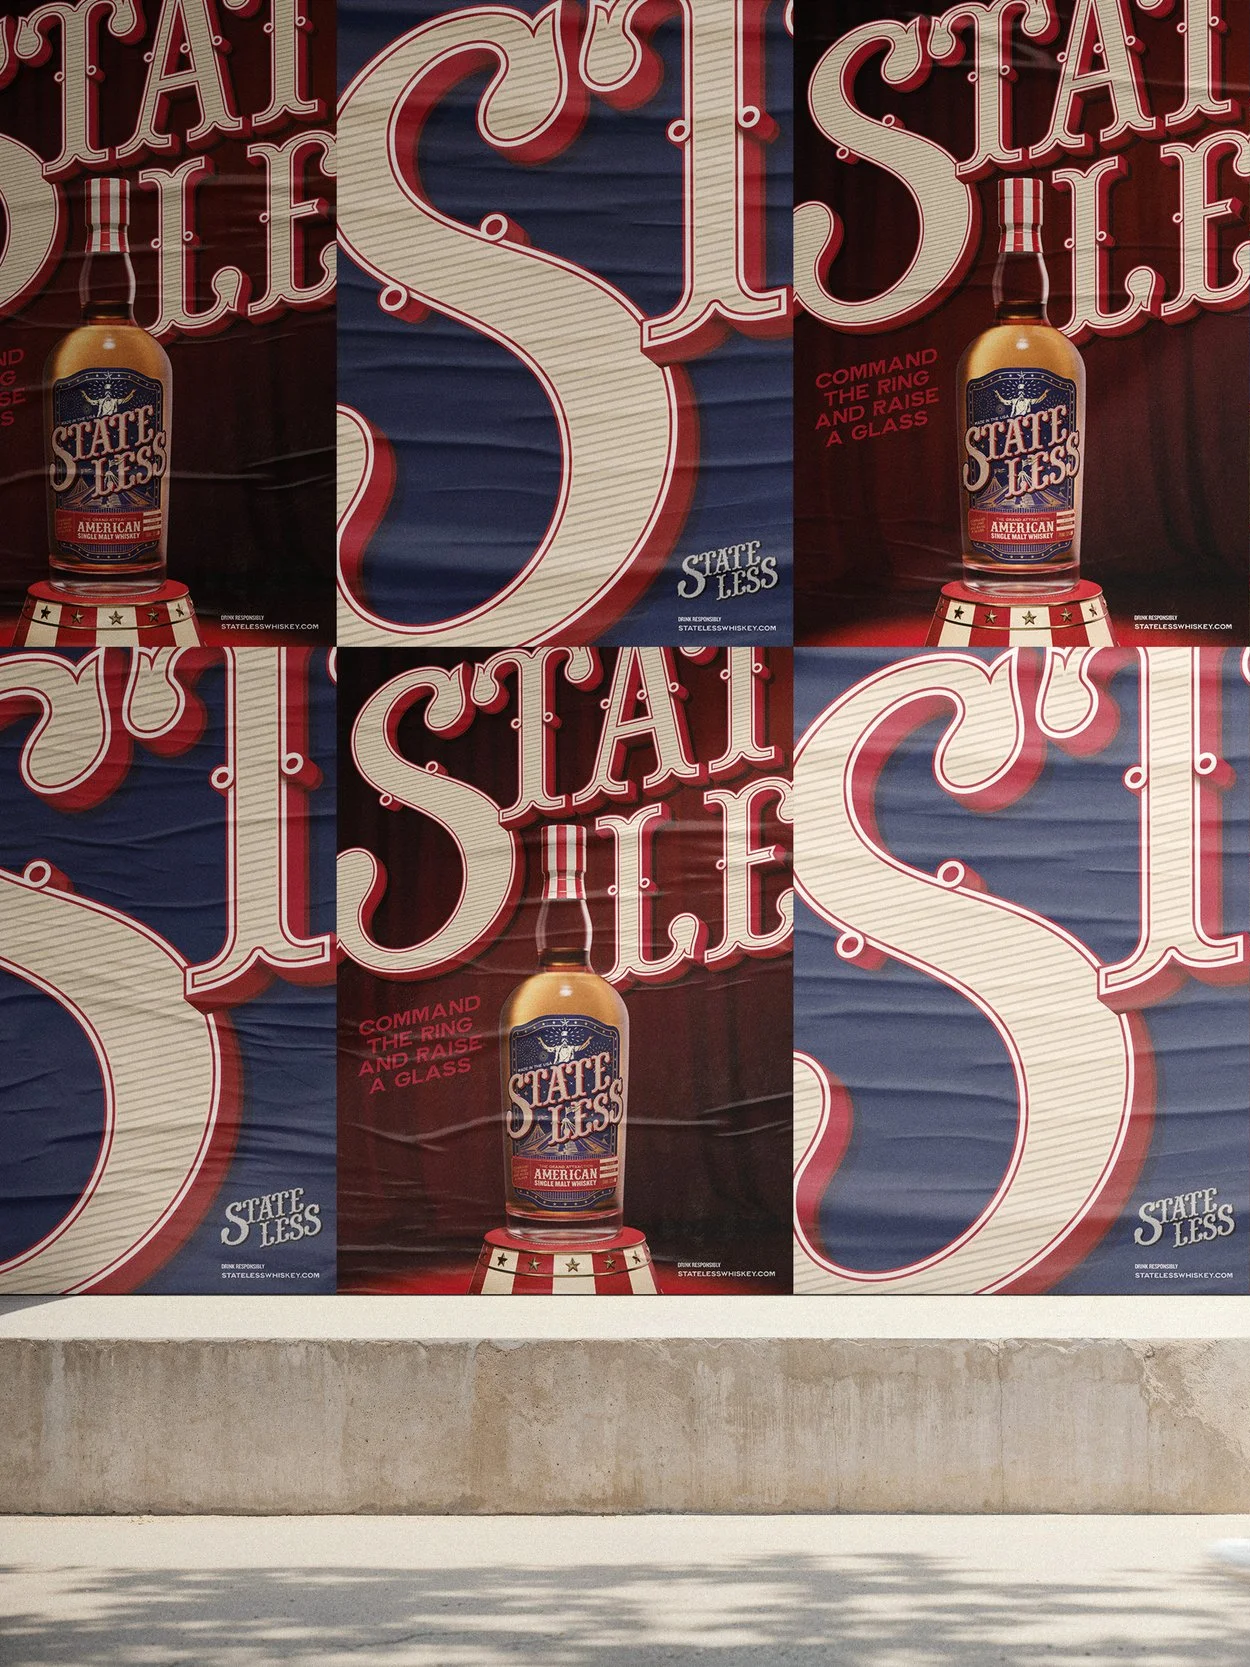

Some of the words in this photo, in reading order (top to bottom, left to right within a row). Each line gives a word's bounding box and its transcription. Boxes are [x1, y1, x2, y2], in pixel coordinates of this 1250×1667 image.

[815, 348, 938, 389] COMMAND
[824, 383, 870, 407] THE
[877, 370, 930, 396] RING
[815, 405, 865, 431] AND
[873, 387, 940, 416] RAISE
[825, 430, 843, 448] A
[851, 410, 928, 440] GLASS
[49, 404, 155, 492] STATE
[91, 430, 167, 499] LESS
[962, 404, 1068, 492] STATE
[1004, 430, 1080, 499] LESS
[78, 521, 141, 533] AMERICAN
[991, 521, 1054, 533] AMERICAN
[677, 540, 761, 598] STATE
[716, 556, 778, 600] LESS
[358, 995, 481, 1036] COMMAND
[367, 1030, 413, 1054] THE
[420, 1017, 473, 1043] RING
[358, 1052, 408, 1078] AND
[416, 1034, 483, 1064] RAISE
[368, 1077, 386, 1095] A
[394, 1057, 472, 1087] GLASS
[505, 1051, 611, 1139] STATE
[547, 1077, 623, 1146] LESS
[534, 1168, 597, 1180] AMERICAN
[220, 1187, 304, 1246] STATE
[259, 1203, 322, 1248] LESS
[1134, 1187, 1218, 1246] STATE
[1173, 1203, 1236, 1248] LESS
